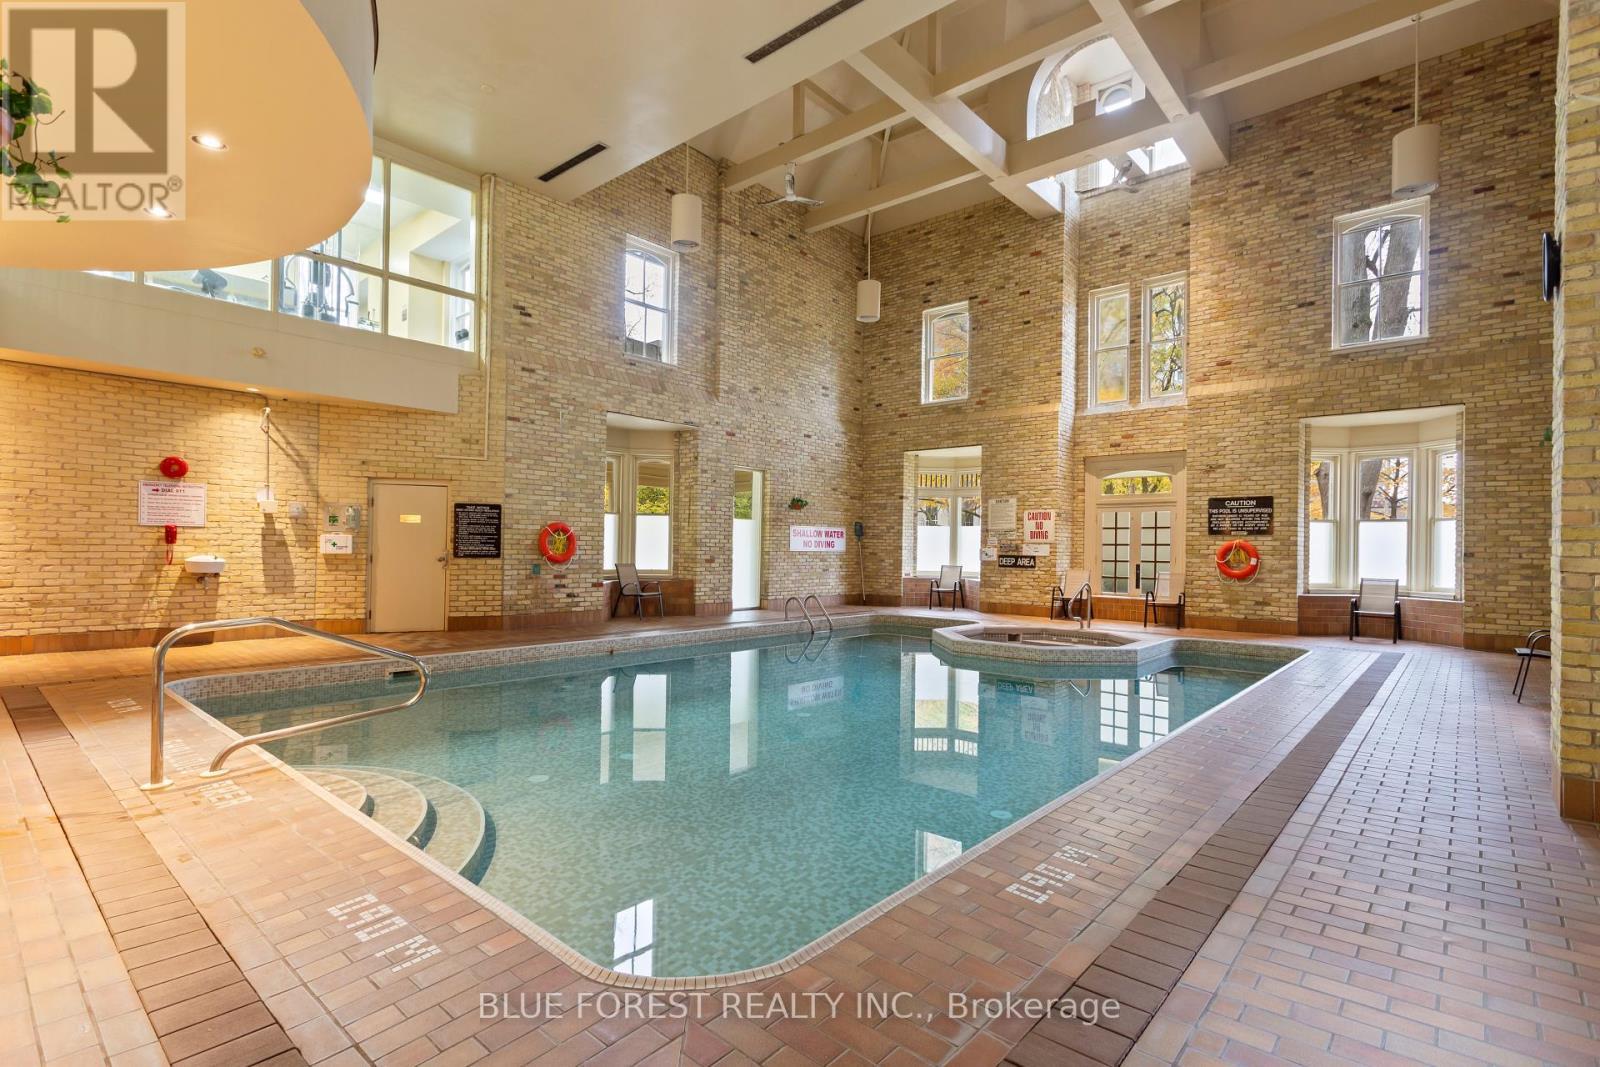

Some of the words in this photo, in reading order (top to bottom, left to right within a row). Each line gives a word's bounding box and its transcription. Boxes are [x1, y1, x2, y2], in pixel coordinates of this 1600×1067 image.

[1028, 512, 1051, 521] CAUTION
[1035, 521, 1044, 530] NO
[793, 529, 823, 538] SHALLOW
[824, 530, 844, 539] WATER
[1030, 530, 1049, 540] DIVING
[803, 540, 813, 548] NO
[813, 540, 835, 549] DIVING
[1000, 557, 1016, 565] DEEP
[1017, 558, 1035, 566] AREA
